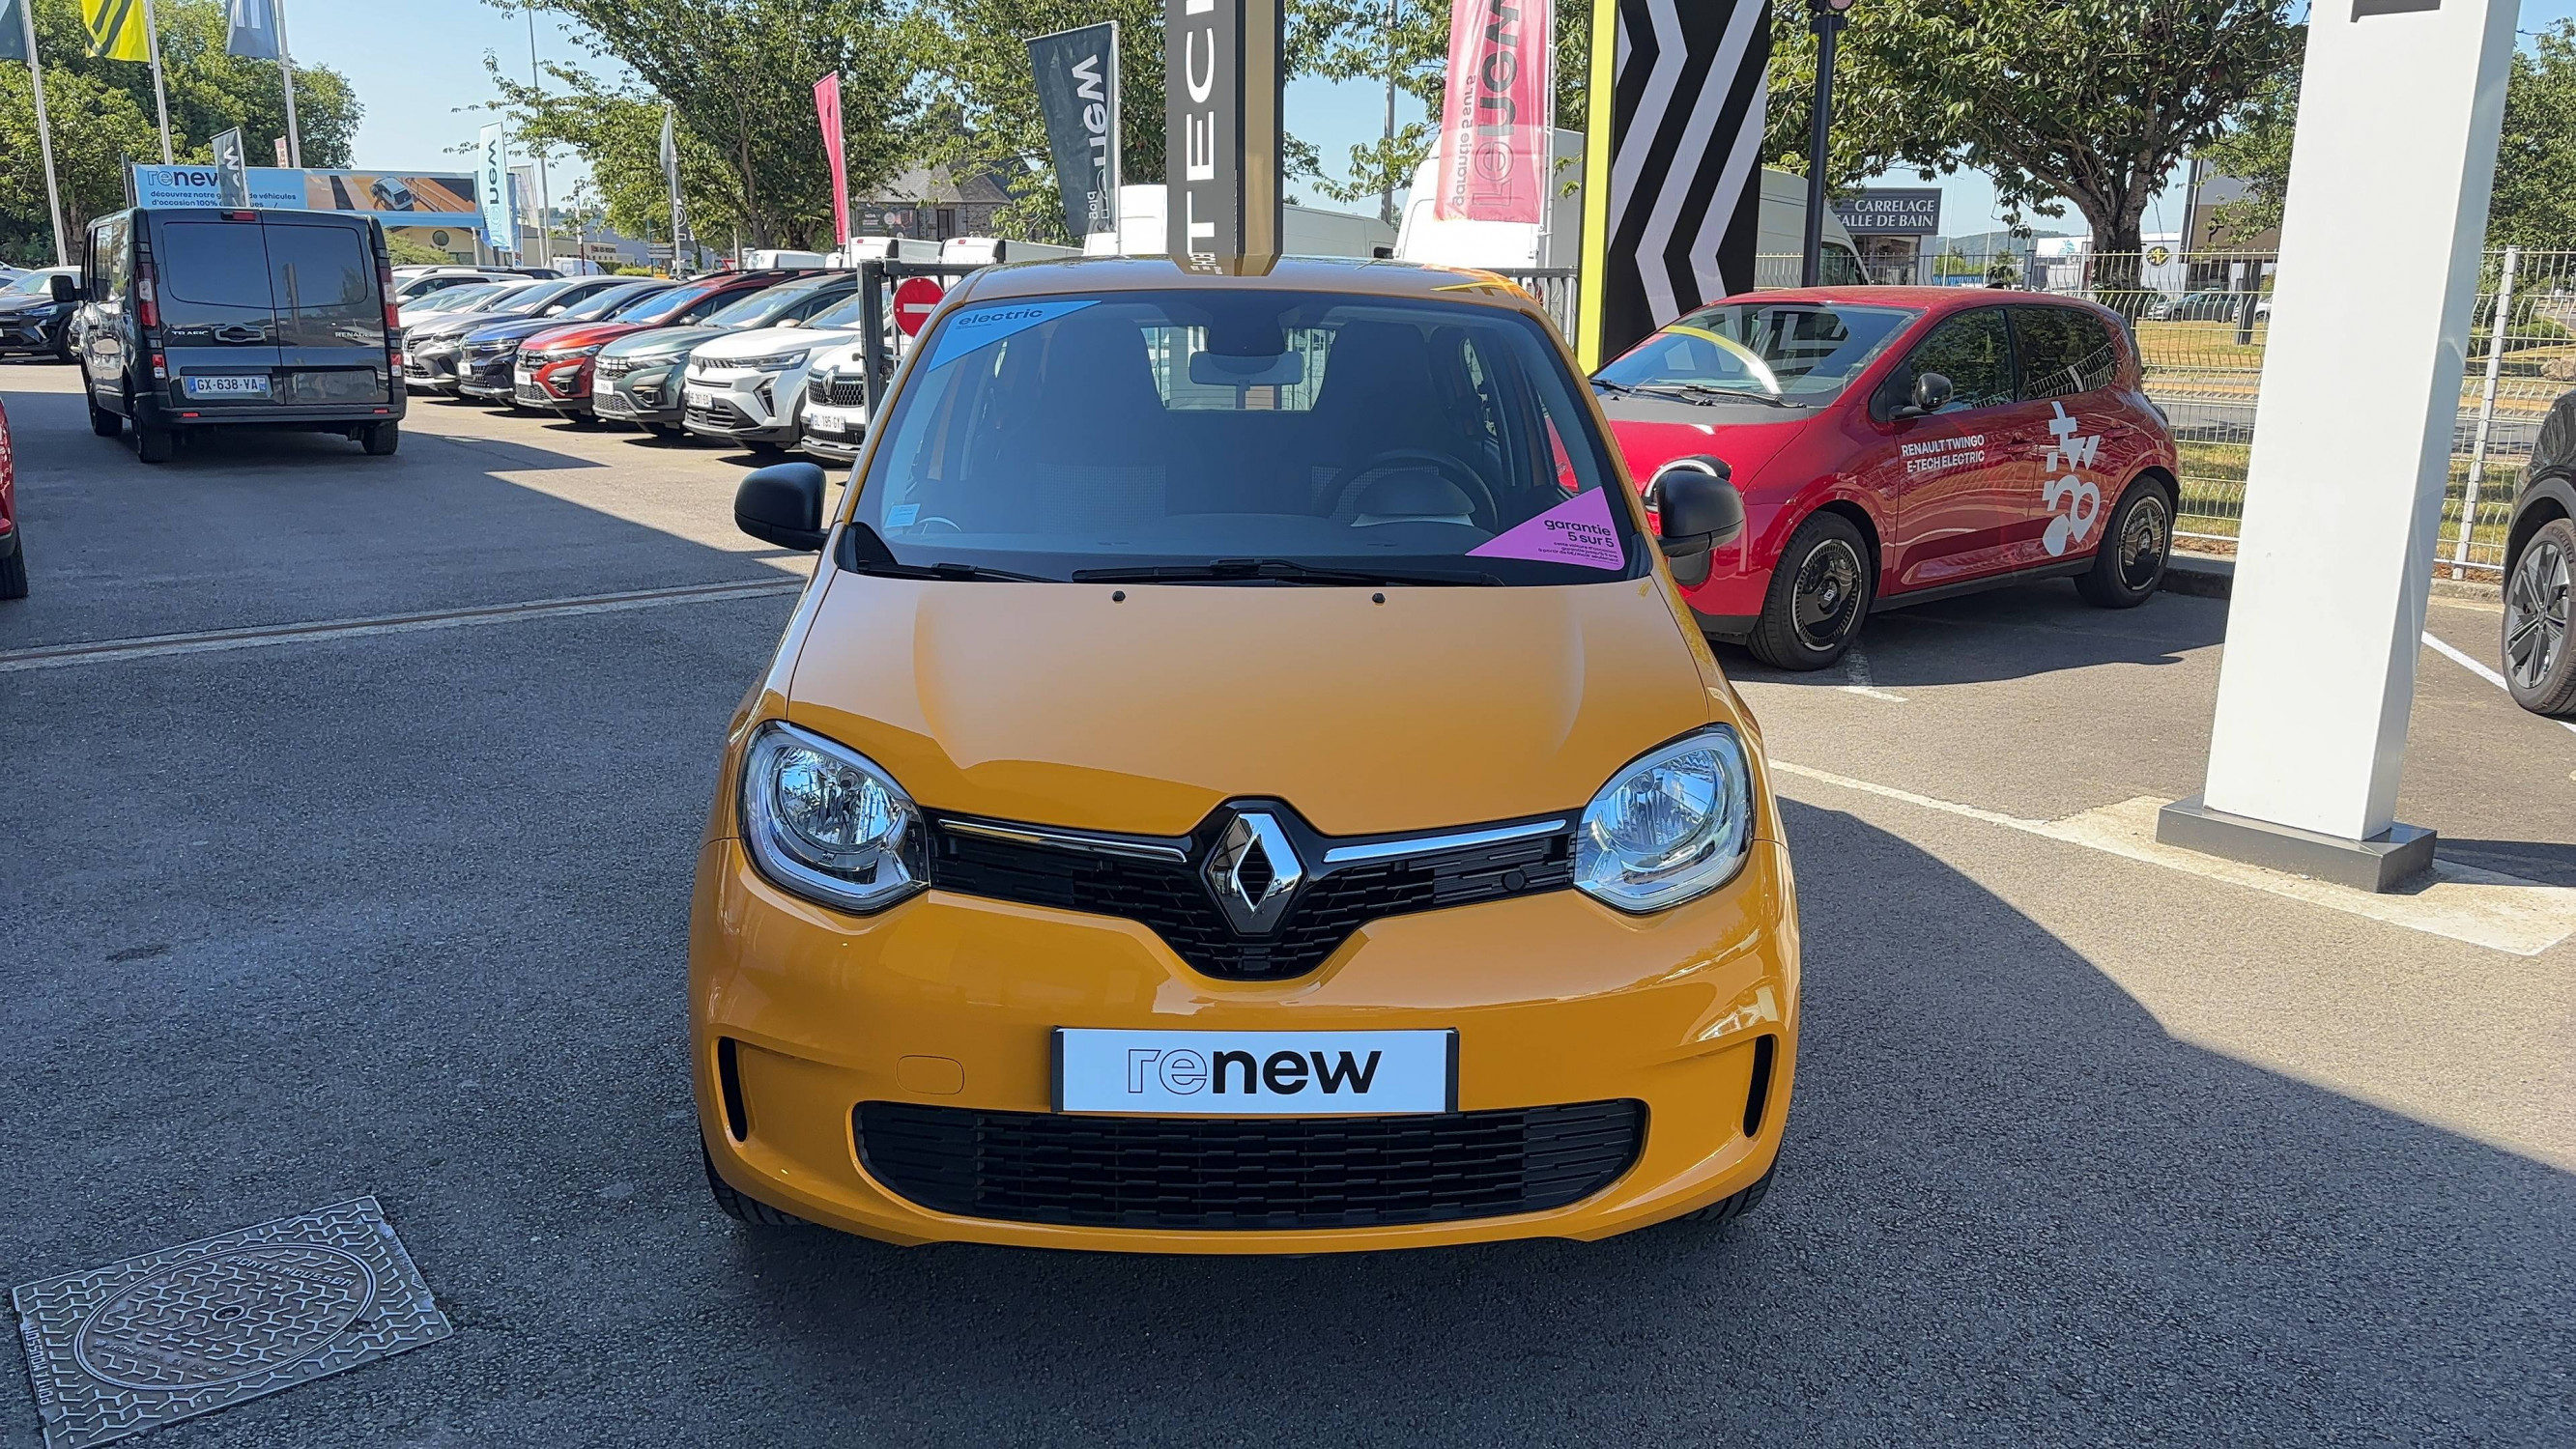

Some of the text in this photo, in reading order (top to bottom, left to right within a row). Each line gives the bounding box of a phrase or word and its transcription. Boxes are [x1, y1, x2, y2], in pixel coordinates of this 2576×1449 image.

[1855, 199, 1935, 212] CARRELAGE
[1876, 214, 1896, 227] DE
[1899, 214, 1933, 227] BAIN
[959, 308, 1044, 326] electric
[197, 379, 258, 390] GX-638-VA
[1902, 434, 1985, 457] RENAULT TWINGO
[1906, 450, 1985, 473] E-TECH ELECTRIC
[1544, 520, 1611, 536] garantie
[1567, 531, 1615, 548] 5 sur 5
[1127, 1048, 1383, 1095] renew
[227, 1256, 272, 1269] PONT
[279, 1266, 357, 1287] MOUSSON
[22, 1324, 48, 1372] MOUSSON
[36, 1378, 55, 1406] PONT
